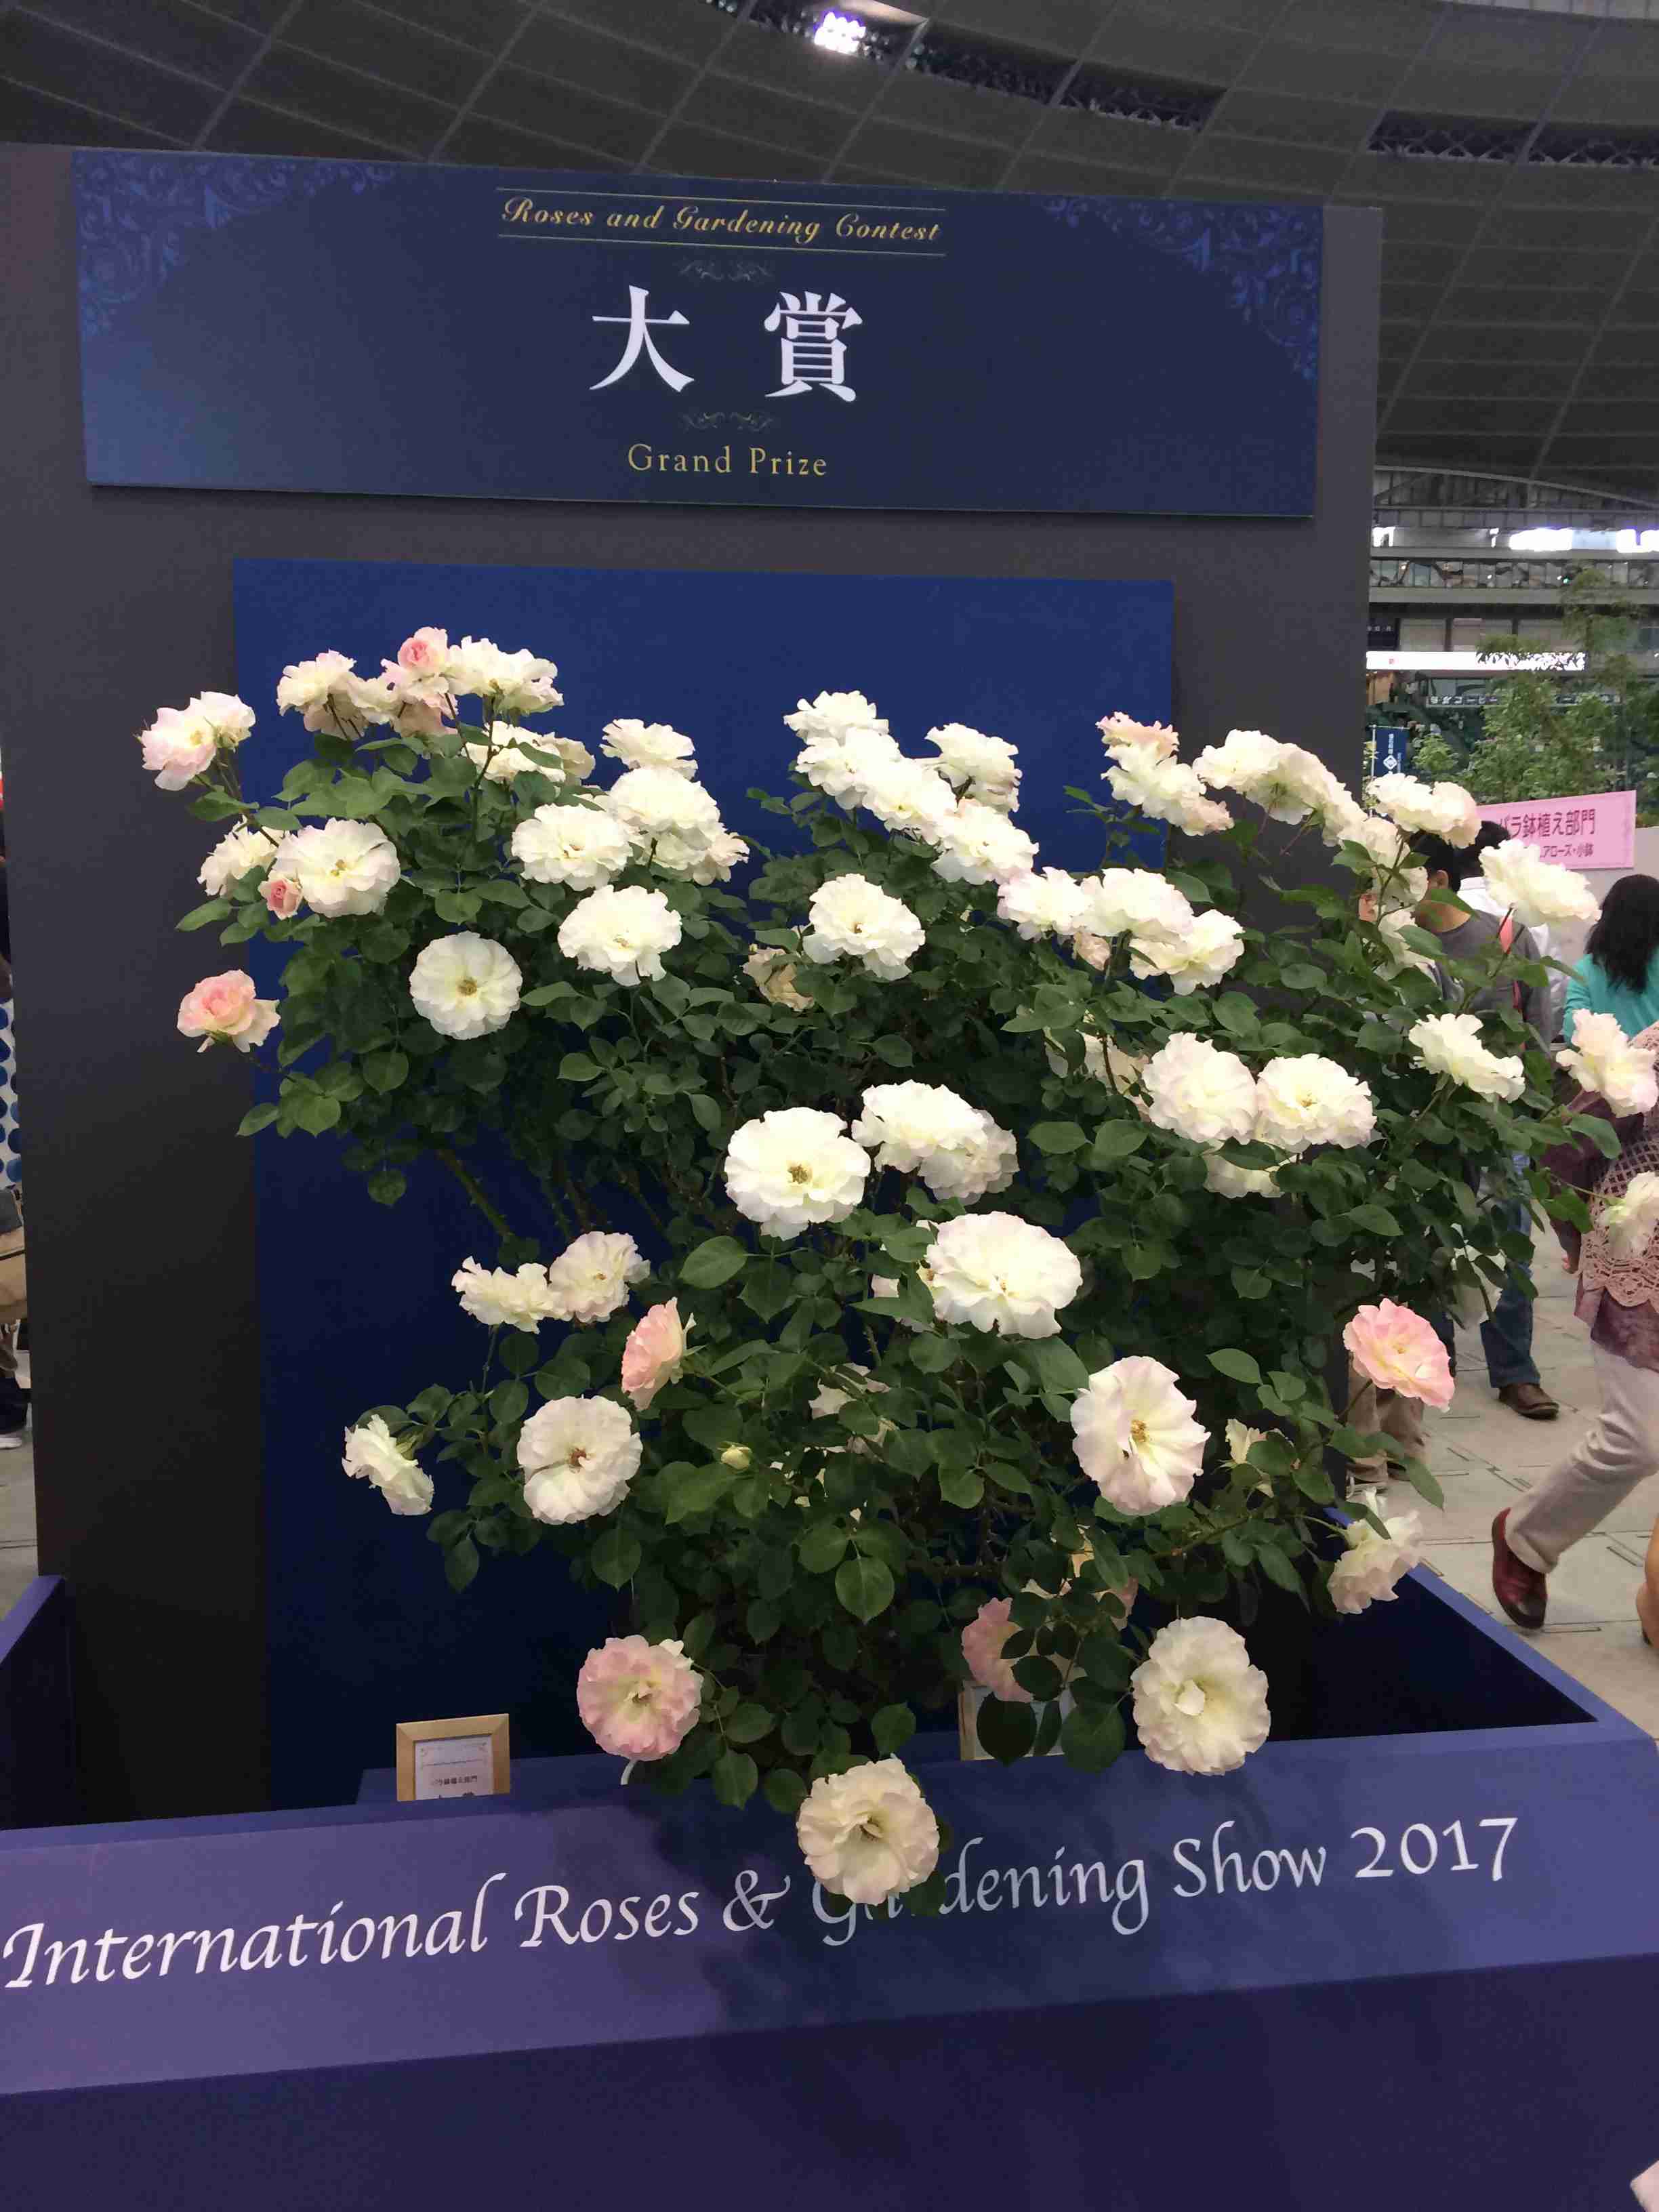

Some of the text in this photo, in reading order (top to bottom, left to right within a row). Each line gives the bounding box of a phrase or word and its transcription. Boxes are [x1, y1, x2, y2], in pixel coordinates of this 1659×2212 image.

[501, 197, 941, 244] Roses and Gardening Contest
[628, 444, 827, 476] Grand Prize
[3, 1817, 1519, 1988] International Roses & Gdening Show 2017
